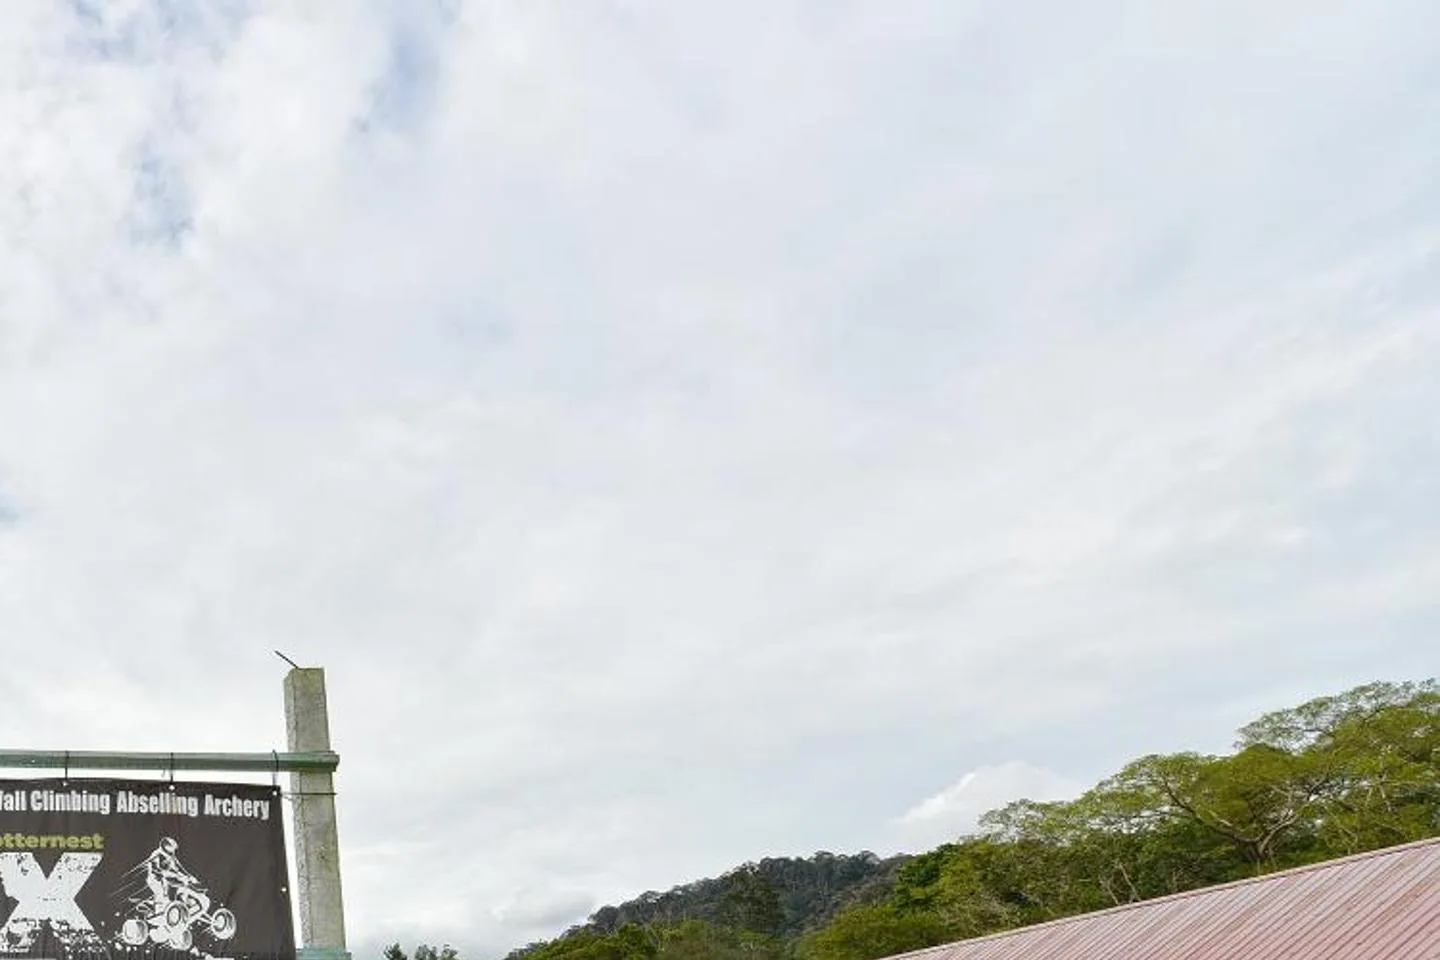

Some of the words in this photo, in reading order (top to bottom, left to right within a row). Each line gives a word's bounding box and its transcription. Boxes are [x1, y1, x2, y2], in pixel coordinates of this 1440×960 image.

[30, 790, 110, 815] Climbing
[116, 791, 199, 817] Abselling
[204, 794, 270, 820] Archery
